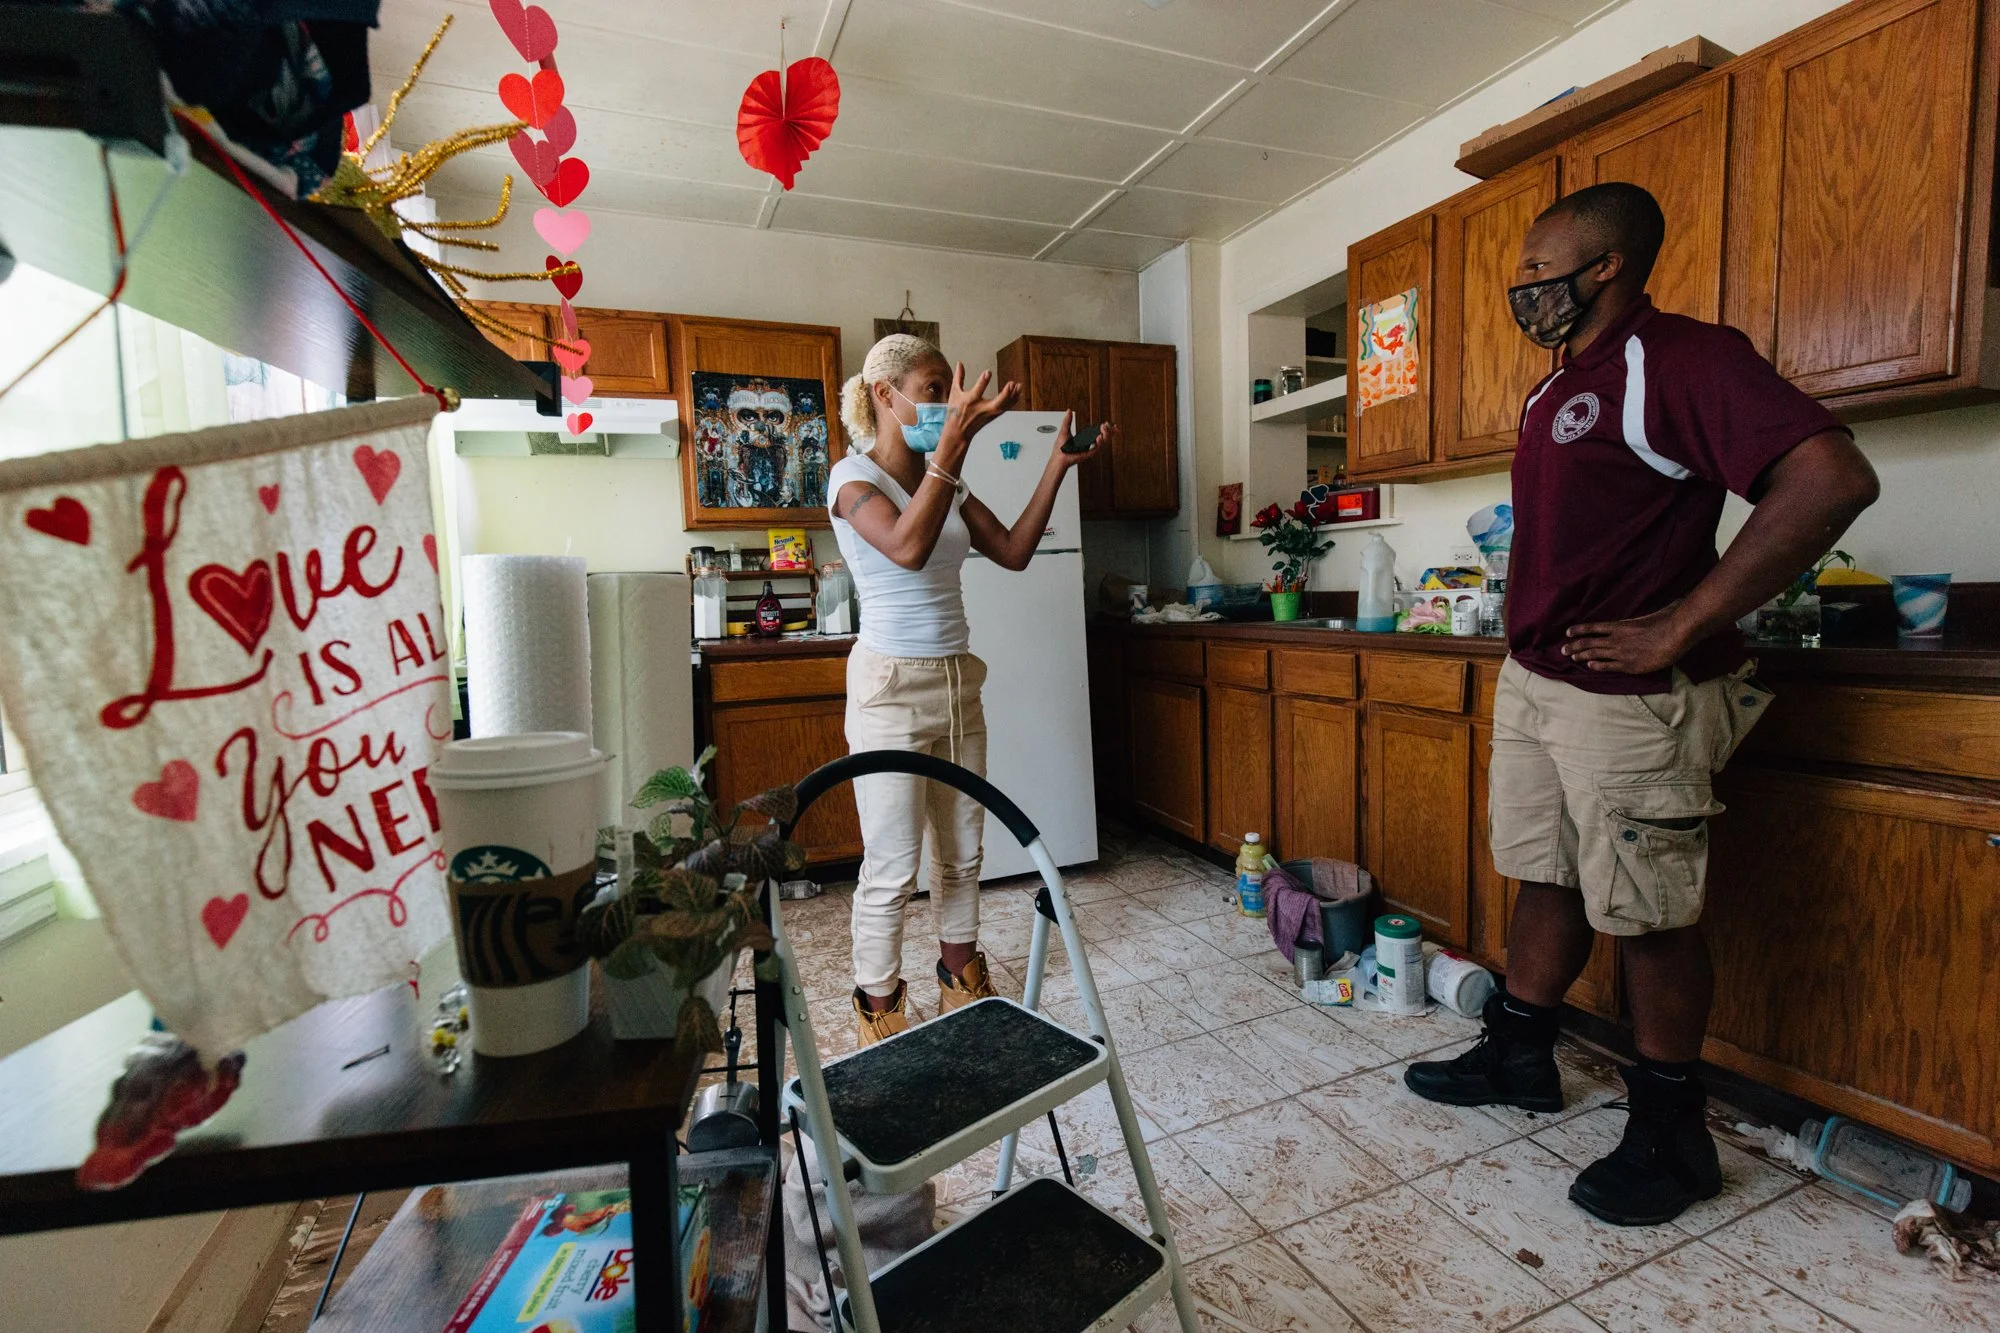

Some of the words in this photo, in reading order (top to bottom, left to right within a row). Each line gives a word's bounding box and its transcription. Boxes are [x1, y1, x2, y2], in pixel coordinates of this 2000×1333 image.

[299, 639, 362, 705] IS
[388, 605, 446, 675] AL
[215, 727, 405, 899] You
[306, 767, 440, 893] NE
[561, 1248, 587, 1283] mixed
[571, 1258, 600, 1295] cherry
[594, 1248, 633, 1300] Dole
[544, 1284, 571, 1311] fruit
